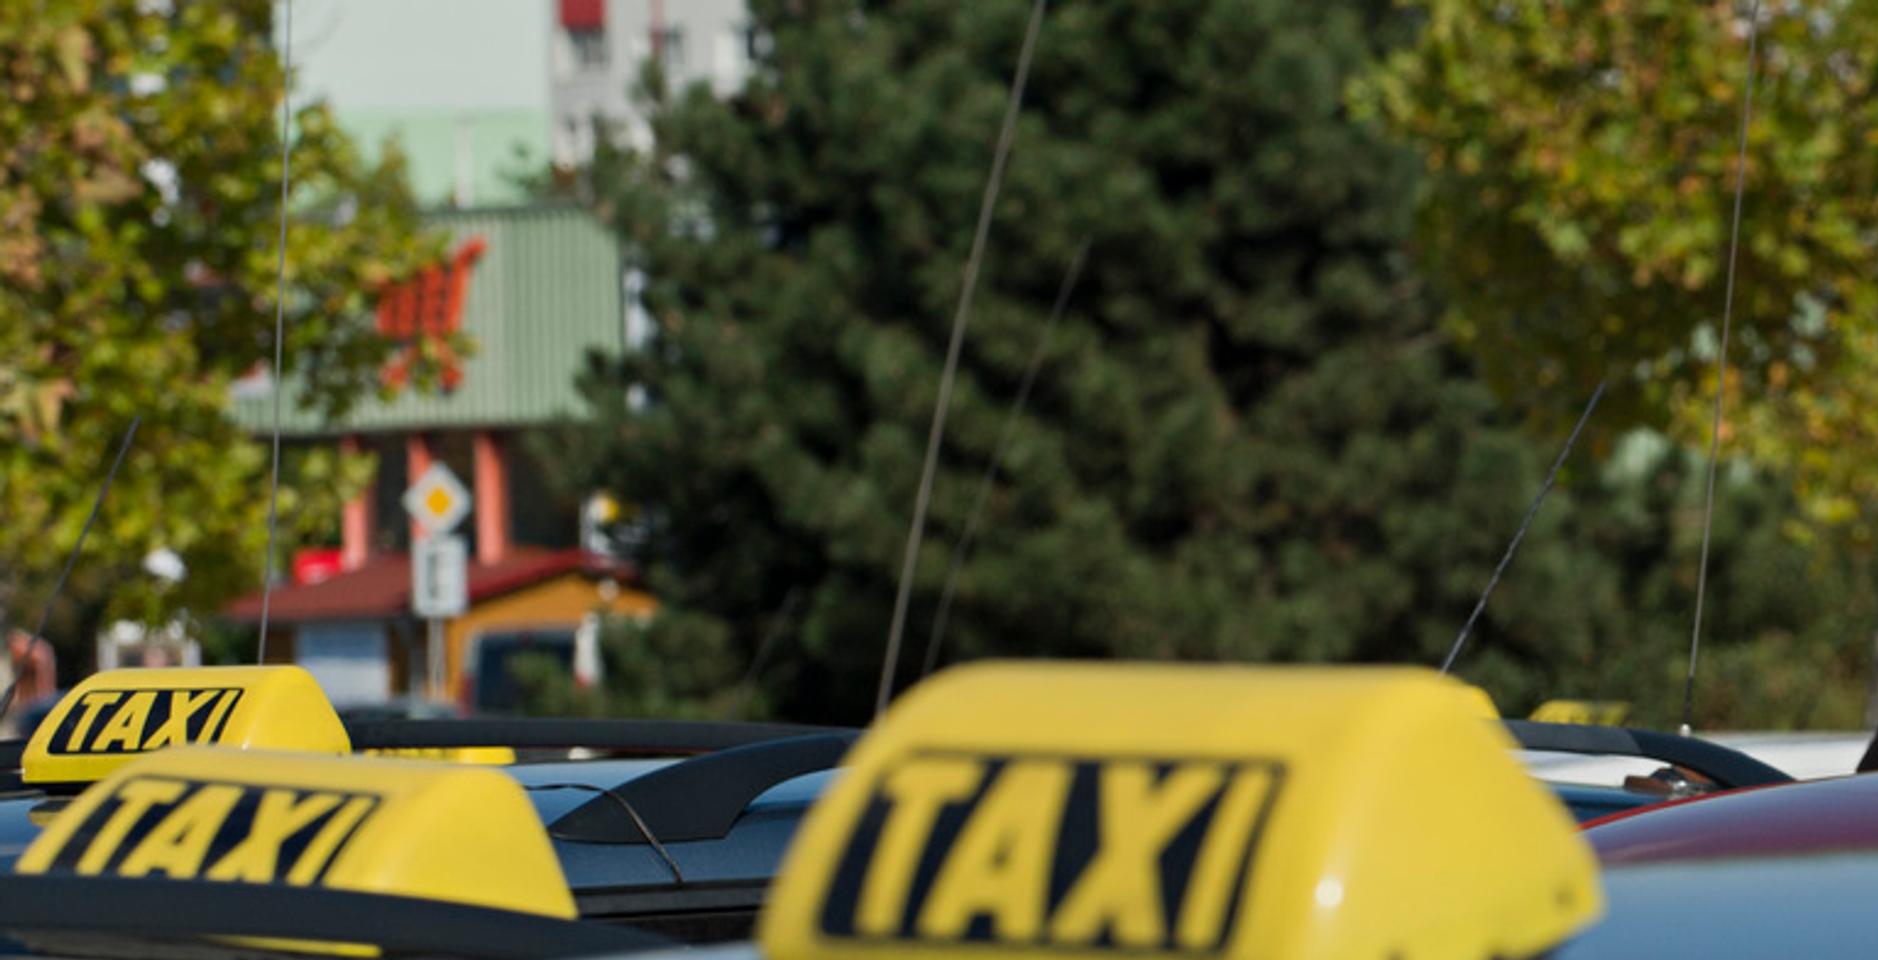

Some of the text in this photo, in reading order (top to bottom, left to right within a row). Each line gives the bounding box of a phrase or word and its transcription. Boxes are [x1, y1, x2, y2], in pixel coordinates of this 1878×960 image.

[65, 691, 240, 752] TAXI
[75, 780, 378, 888] TAXI
[852, 757, 1274, 950] TAXI
